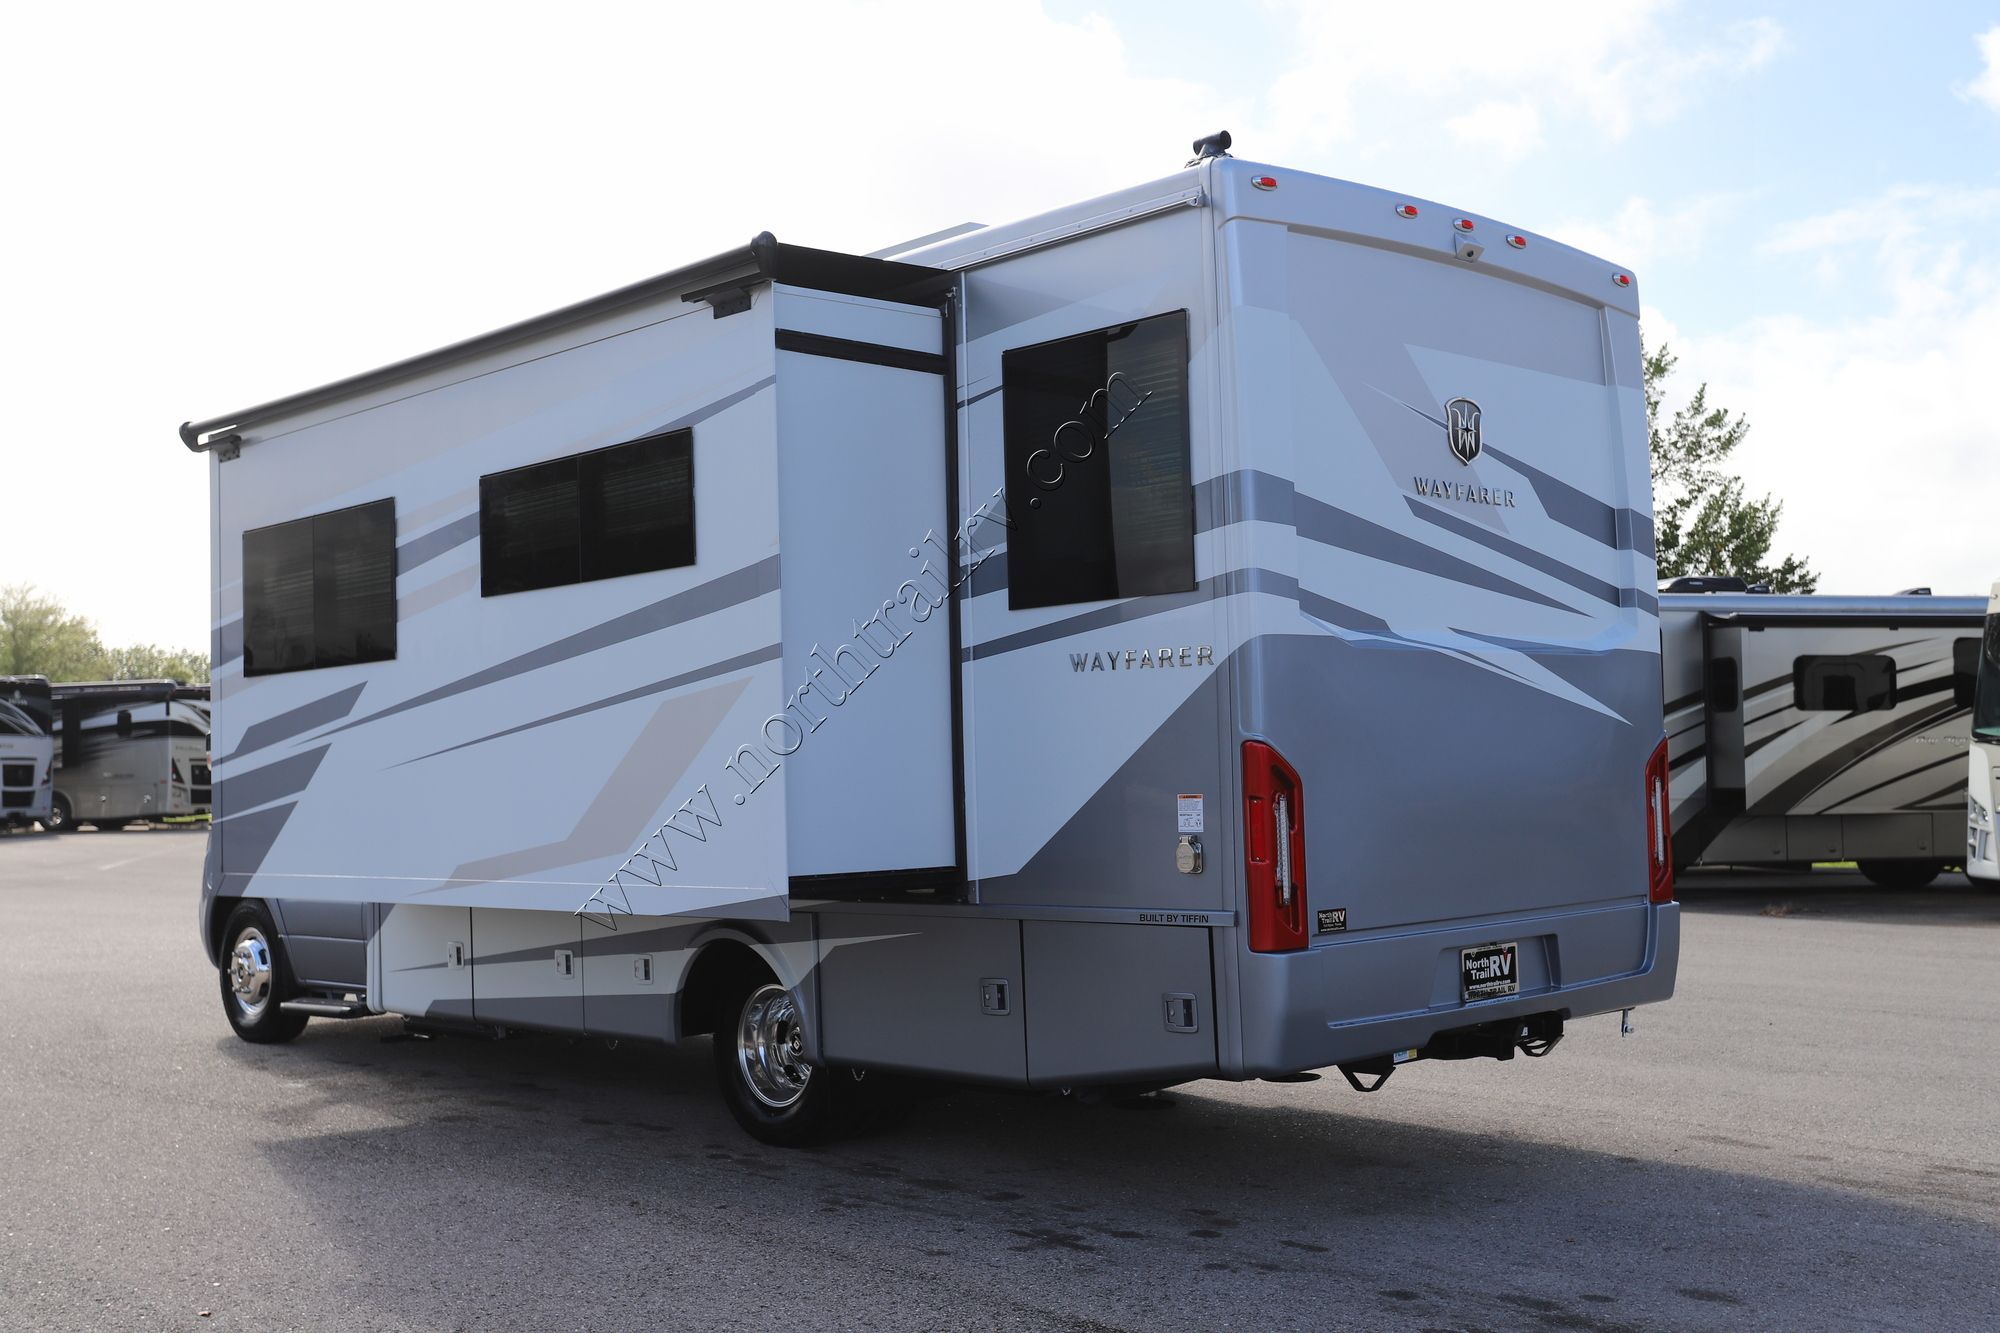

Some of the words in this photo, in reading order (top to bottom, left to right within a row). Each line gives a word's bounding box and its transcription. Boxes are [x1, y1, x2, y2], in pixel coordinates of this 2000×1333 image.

[1413, 476, 1516, 508] WAYFARER
[1069, 645, 1215, 673] WAYFARER
[1139, 913, 1165, 922] BUILT
[1166, 914, 1179, 923] BY
[1181, 914, 1209, 923] TIFFIN
[1332, 910, 1345, 923] RV
[1466, 957, 1489, 970] North
[1490, 954, 1511, 977] RV
[1471, 968, 1489, 980] Trail
[1507, 984, 1516, 992] RV
